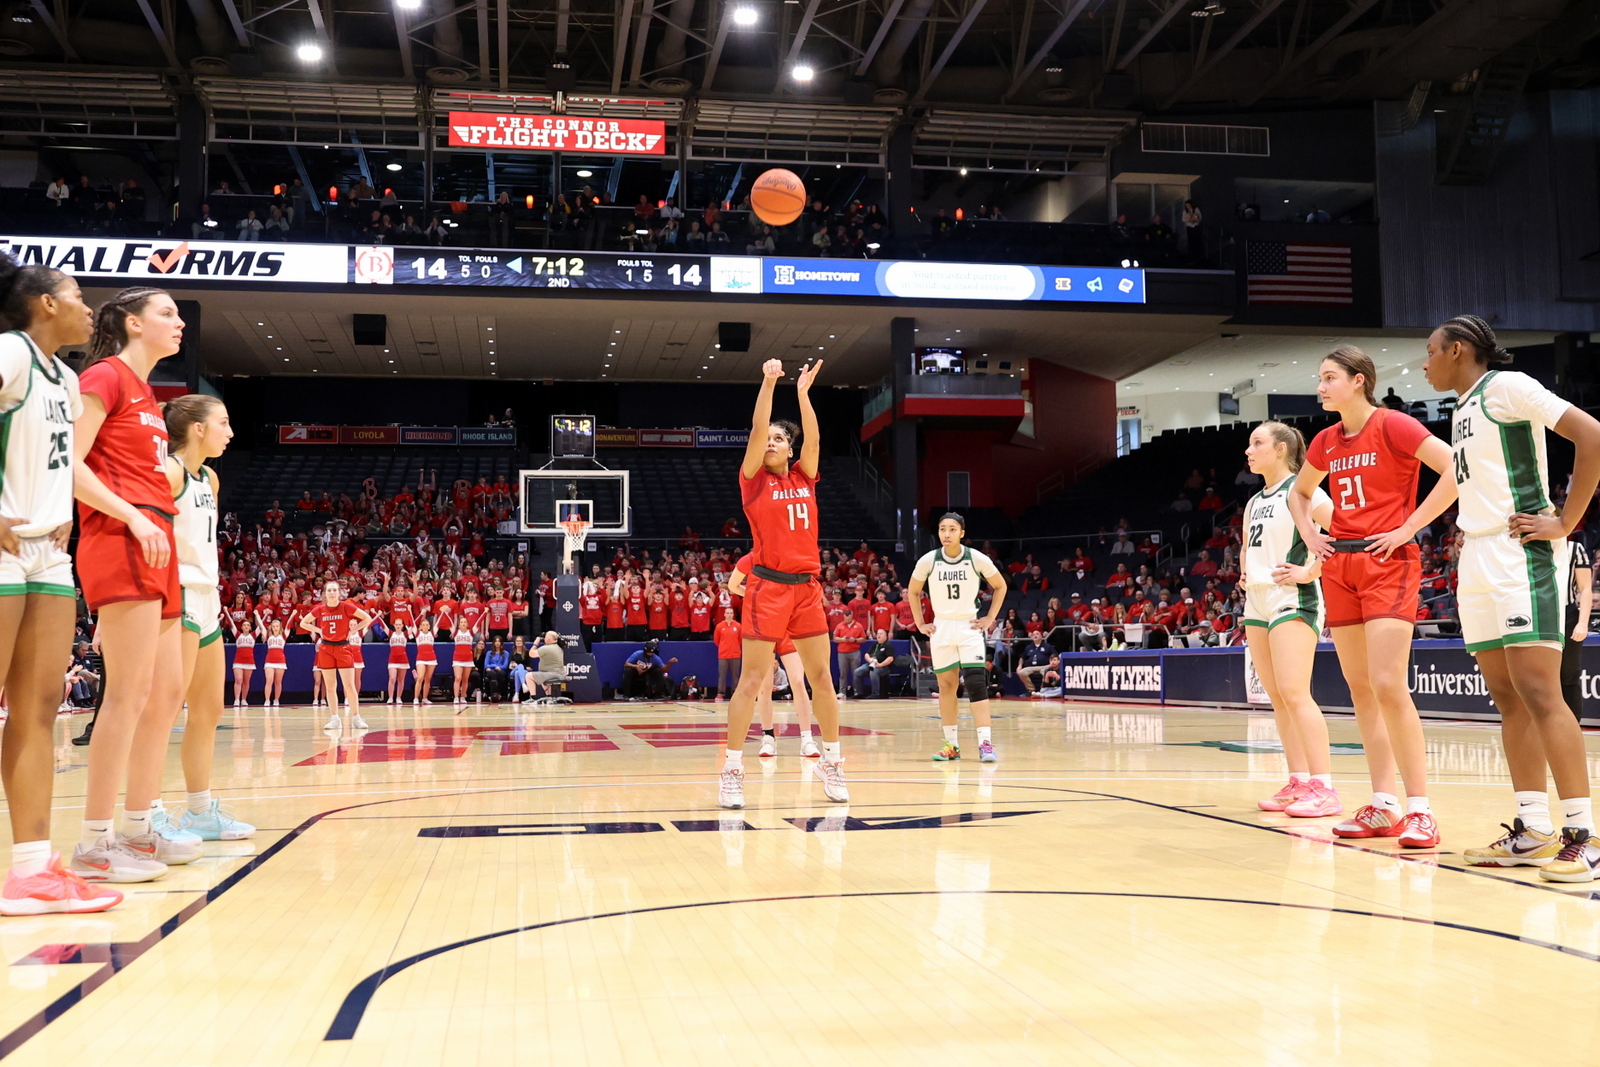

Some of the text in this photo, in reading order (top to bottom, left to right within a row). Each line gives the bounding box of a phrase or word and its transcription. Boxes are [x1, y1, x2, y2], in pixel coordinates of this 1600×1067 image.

[497, 116, 620, 132] THE CONNOR
[470, 125, 647, 151] FLIGHT DECK
[0, 239, 285, 277] INALFORMS
[459, 255, 472, 263] TOL
[617, 259, 654, 268] FOULS TOL
[411, 257, 448, 280] 14
[460, 264, 471, 278] 5
[481, 265, 491, 278] 0
[532, 257, 584, 276] 7:12
[625, 269, 633, 282] 1
[643, 269, 653, 282] 5
[667, 264, 702, 286] 14
[795, 271, 860, 282] HOMETOWN
[547, 278, 570, 288] 2ND
[353, 431, 385, 440] LOYOLA
[462, 433, 513, 441] RHODE ISLAND
[725, 435, 749, 443] LOUIS
[48, 430, 69, 470] 25
[1453, 447, 1470, 485] 24
[1338, 474, 1366, 511] 21
[787, 502, 810, 531] 14
[1248, 523, 1264, 548] 22
[938, 570, 968, 582] LAUREL
[946, 583, 961, 600] 13
[329, 622, 336, 634] 2
[1065, 665, 1162, 692] DAYTON FLYERS
